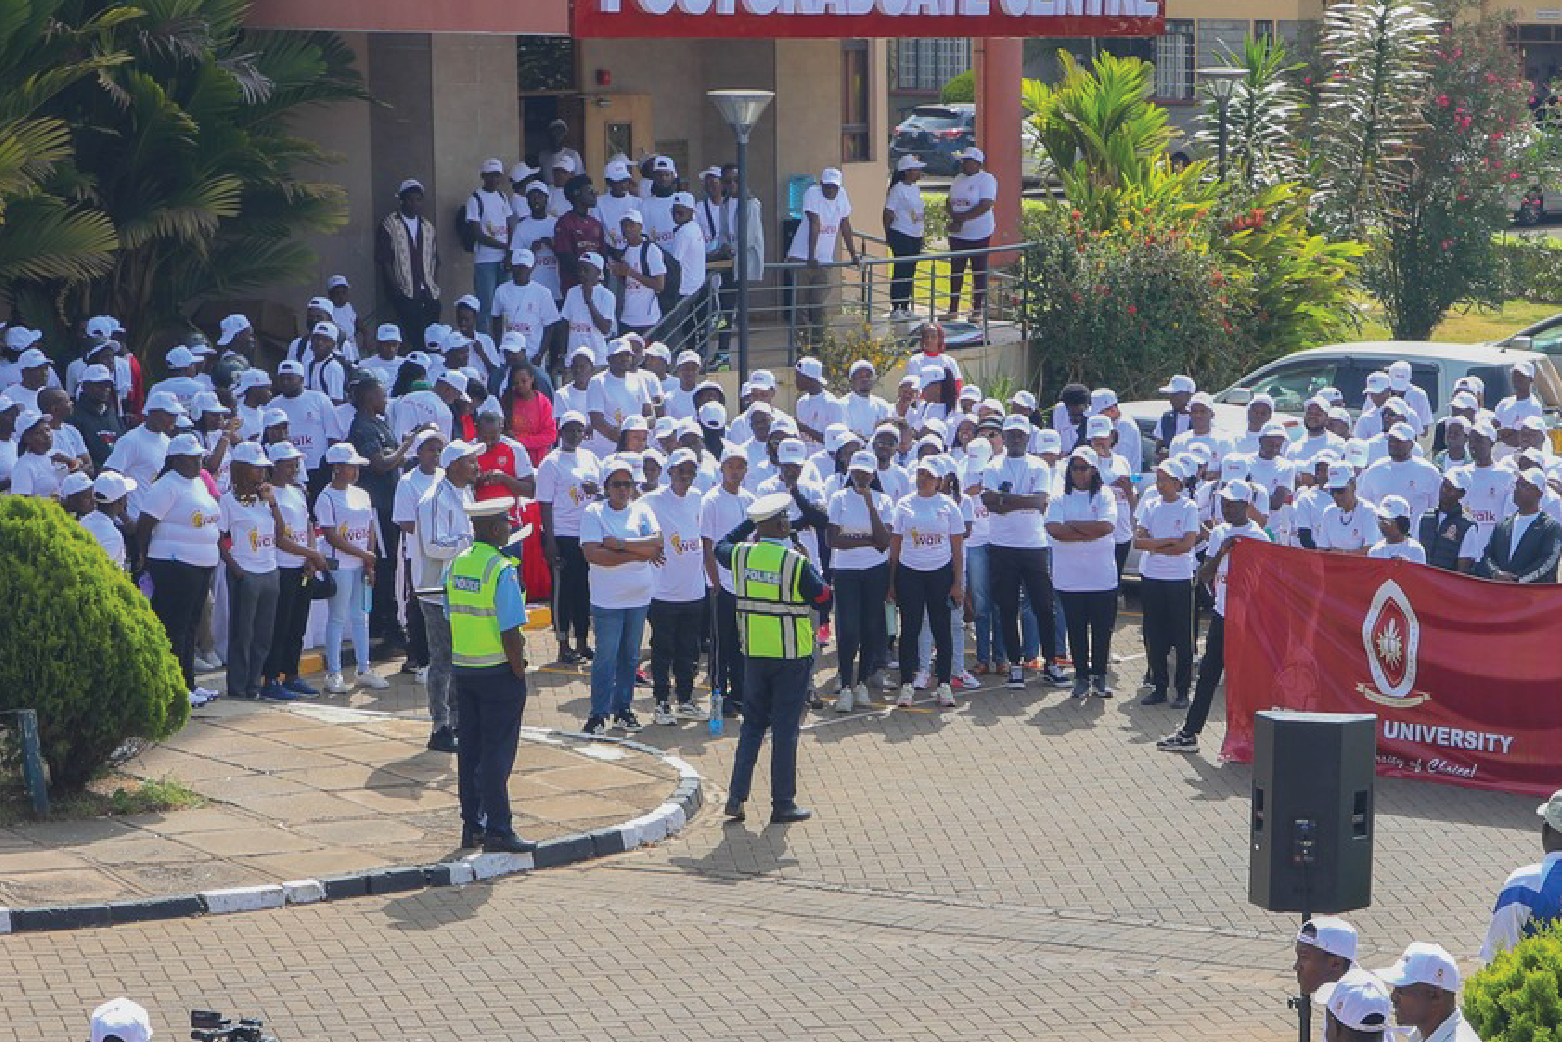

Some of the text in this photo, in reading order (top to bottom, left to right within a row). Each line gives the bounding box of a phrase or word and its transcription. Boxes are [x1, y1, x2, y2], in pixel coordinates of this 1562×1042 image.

[915, 532, 943, 545] walk
[1383, 719, 1514, 754] UNIVERSITY
[1409, 758, 1422, 773] of
